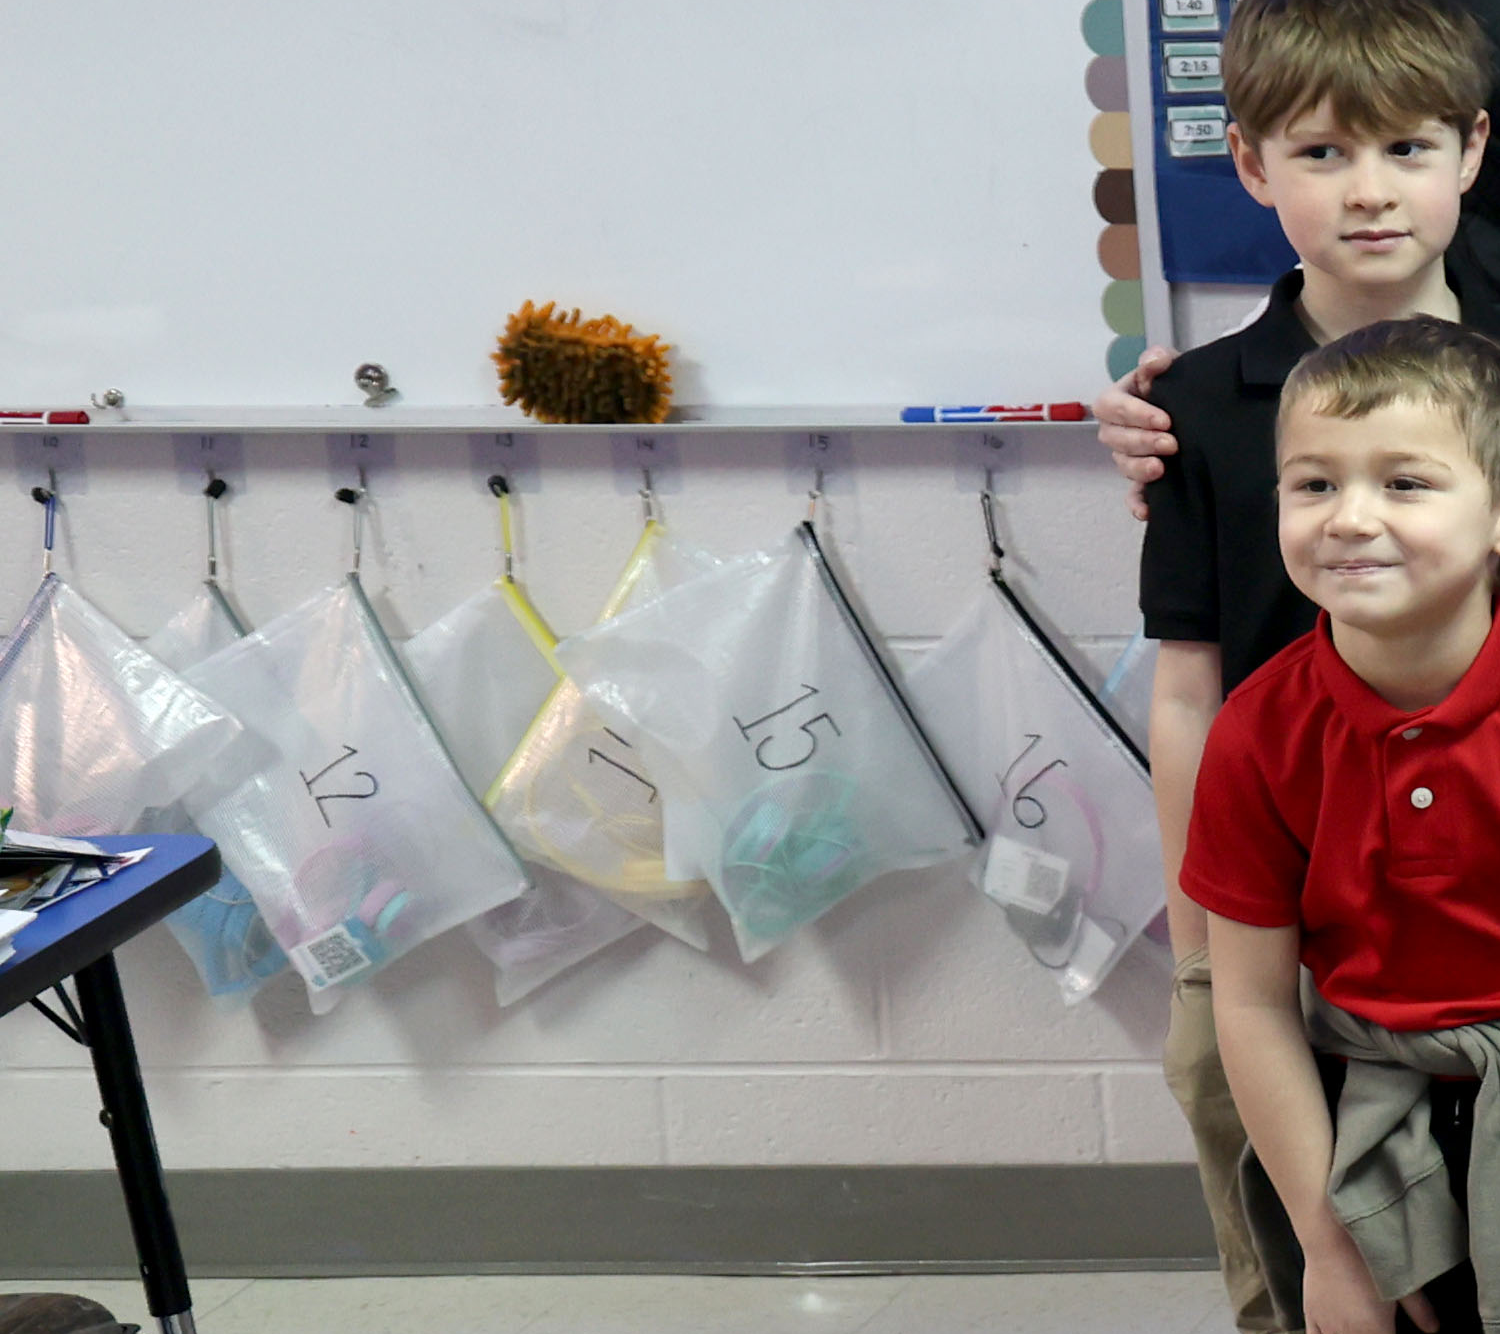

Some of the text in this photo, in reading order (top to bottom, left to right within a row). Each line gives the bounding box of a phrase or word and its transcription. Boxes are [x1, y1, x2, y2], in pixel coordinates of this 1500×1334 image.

[636, 437, 655, 452] 14
[808, 433, 829, 452] 15
[733, 683, 842, 771] 15
[300, 745, 378, 829] 12
[995, 733, 1069, 830] 16
